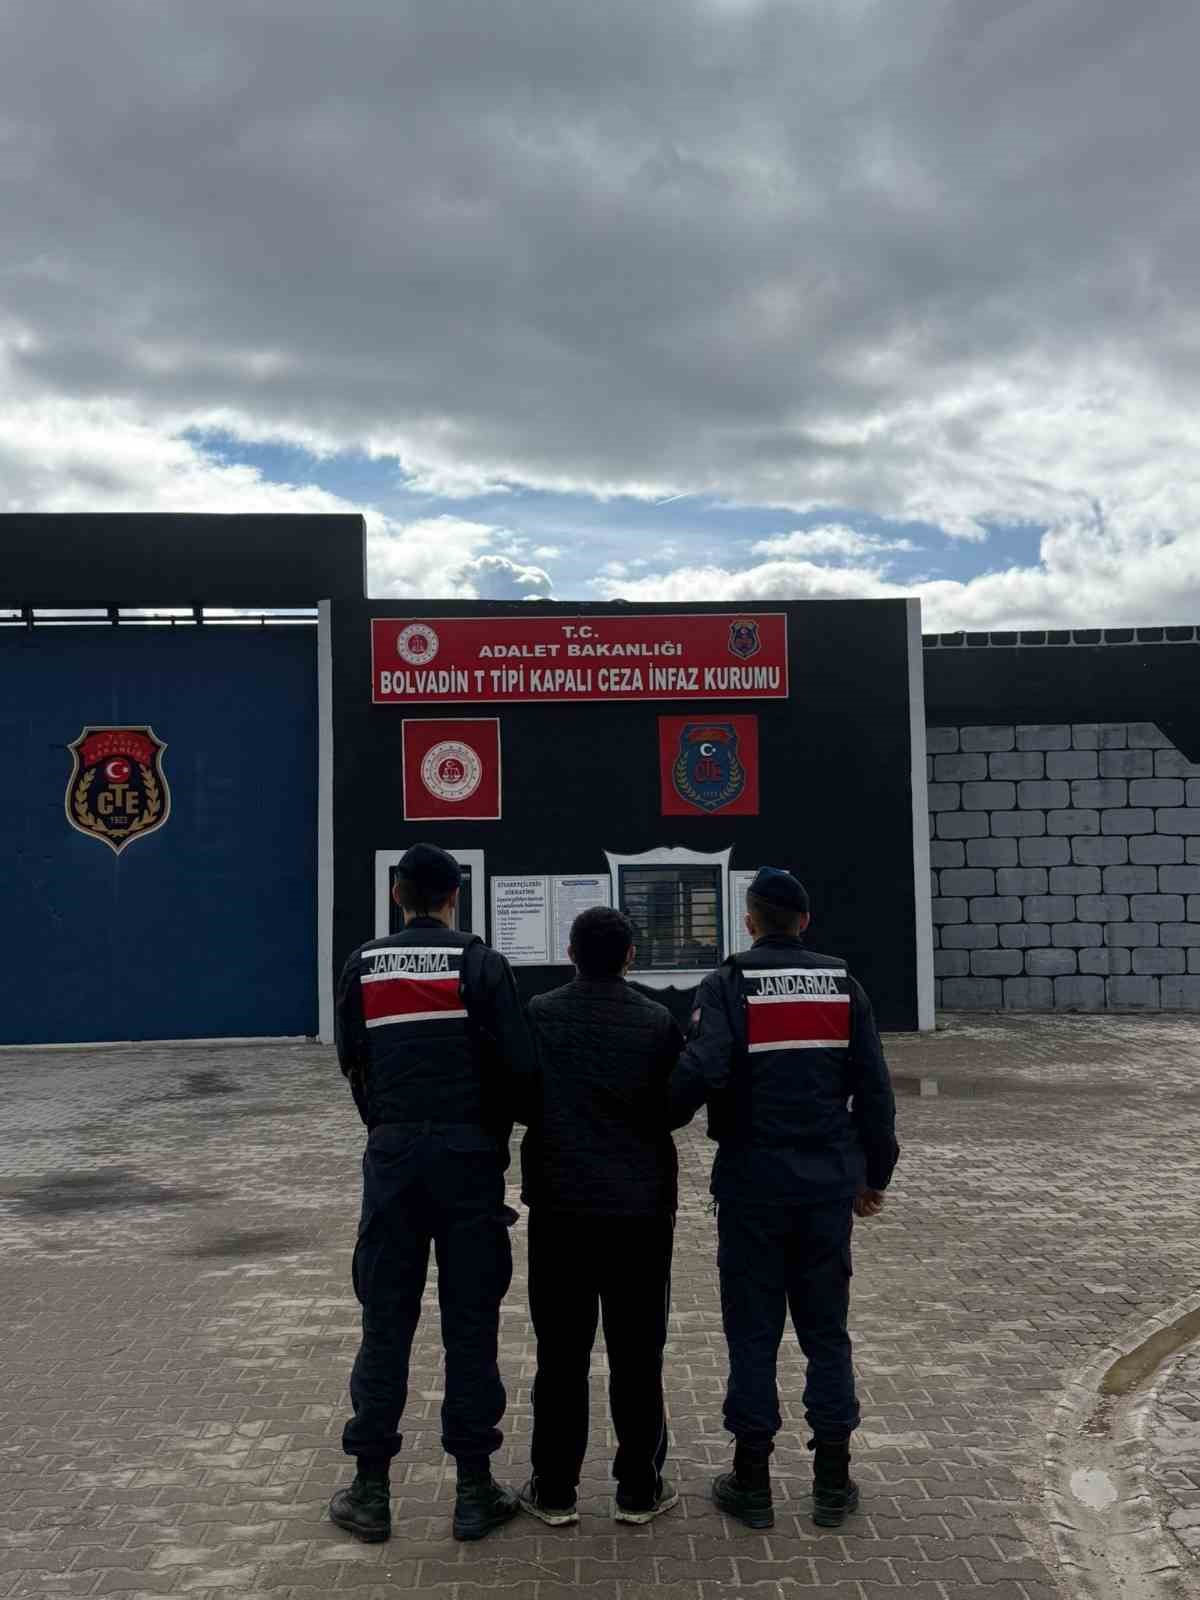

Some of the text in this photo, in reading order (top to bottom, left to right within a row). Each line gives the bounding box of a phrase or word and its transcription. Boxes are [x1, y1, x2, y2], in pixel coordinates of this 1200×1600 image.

[562, 626, 599, 638] T.C.
[479, 640, 683, 658] ADALET BAKANLIĞI
[380, 662, 780, 694] BOLVADİN T TİPİ KAPALI CEZA İNFAZ KURUMU
[97, 783, 139, 815] CTE
[369, 953, 450, 974] JANDARMA
[757, 976, 839, 996] JANDARMA
